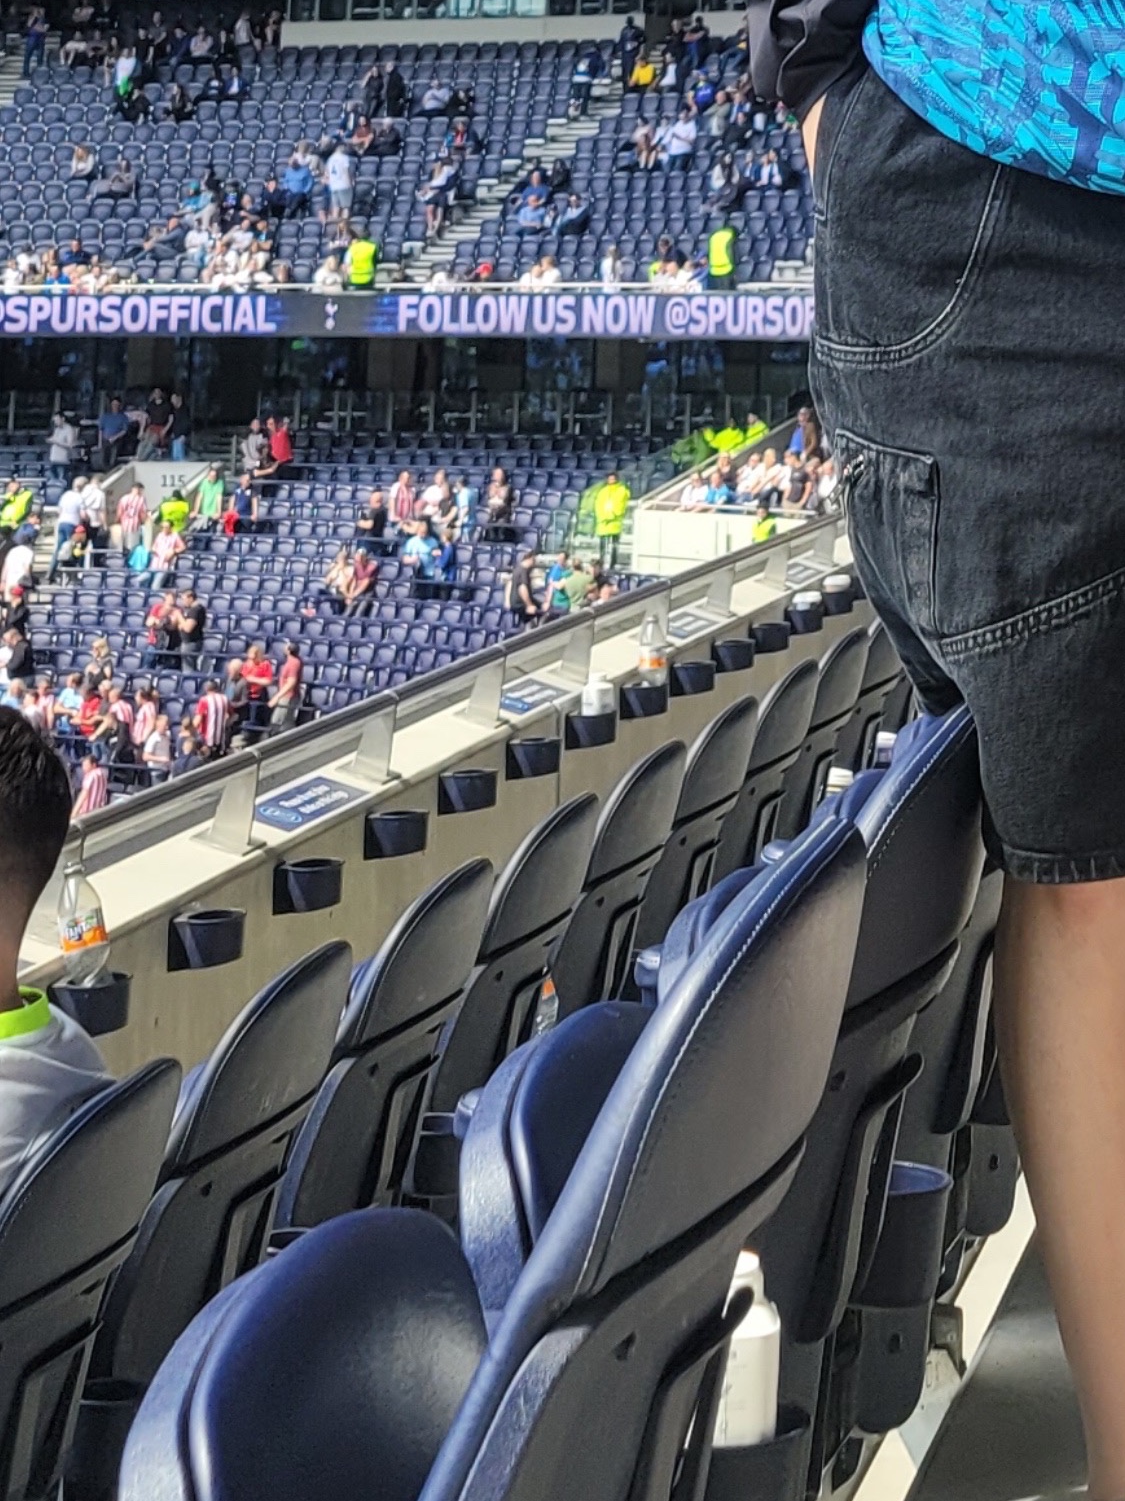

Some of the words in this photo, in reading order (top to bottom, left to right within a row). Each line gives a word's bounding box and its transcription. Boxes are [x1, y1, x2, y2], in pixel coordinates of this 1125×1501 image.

[0, 295, 278, 333] SPURSOFFICIAL
[397, 295, 528, 333] FOLLOW
[531, 295, 577, 333] US
[581, 295, 656, 333] NOW
[161, 474, 187, 487] 115
